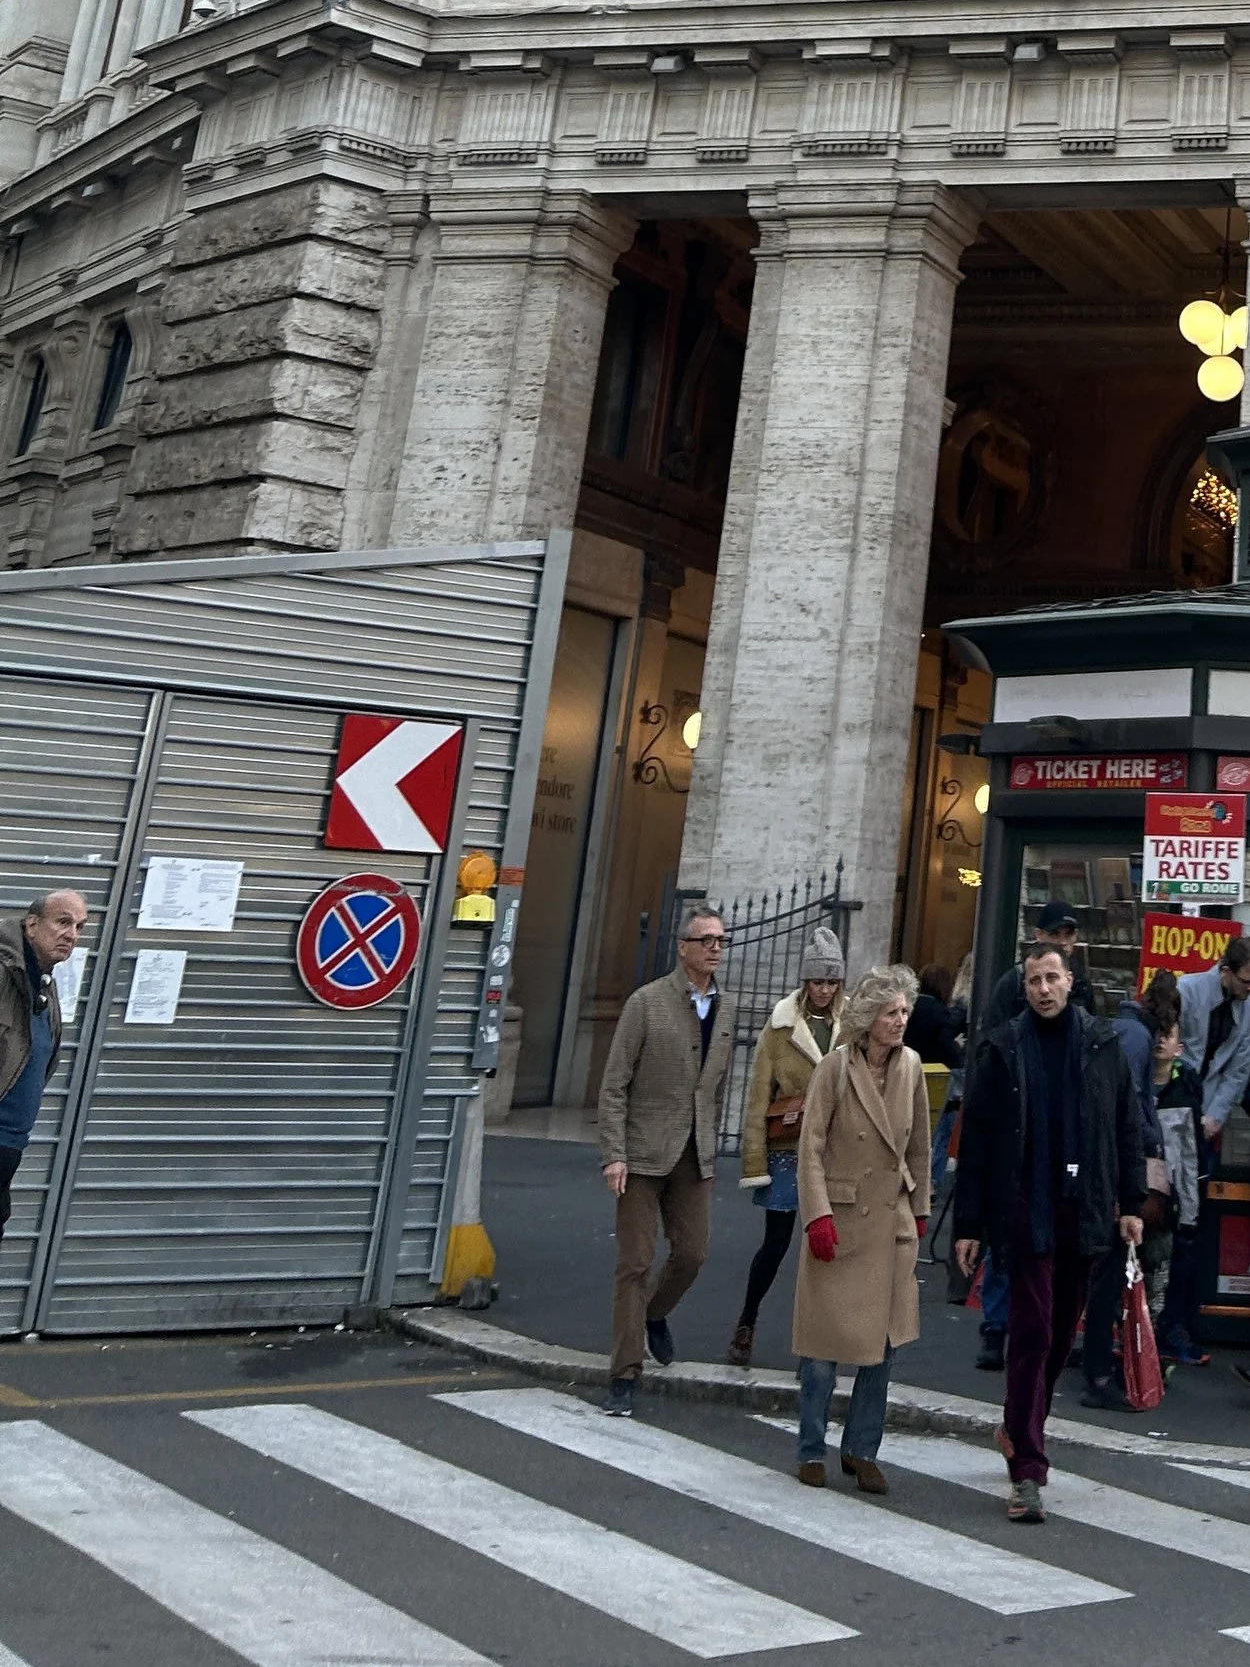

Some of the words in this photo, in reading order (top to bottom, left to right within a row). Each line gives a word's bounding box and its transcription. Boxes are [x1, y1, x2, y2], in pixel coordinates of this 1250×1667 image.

[1034, 759, 1102, 780] TICKET
[1106, 758, 1157, 779] HERE
[1150, 839, 1239, 859] TARIFFE
[1158, 861, 1230, 880] RATES
[1180, 882, 1200, 893] GO
[1201, 883, 1240, 894] ROME
[1150, 925, 1231, 961] HOP-ON
